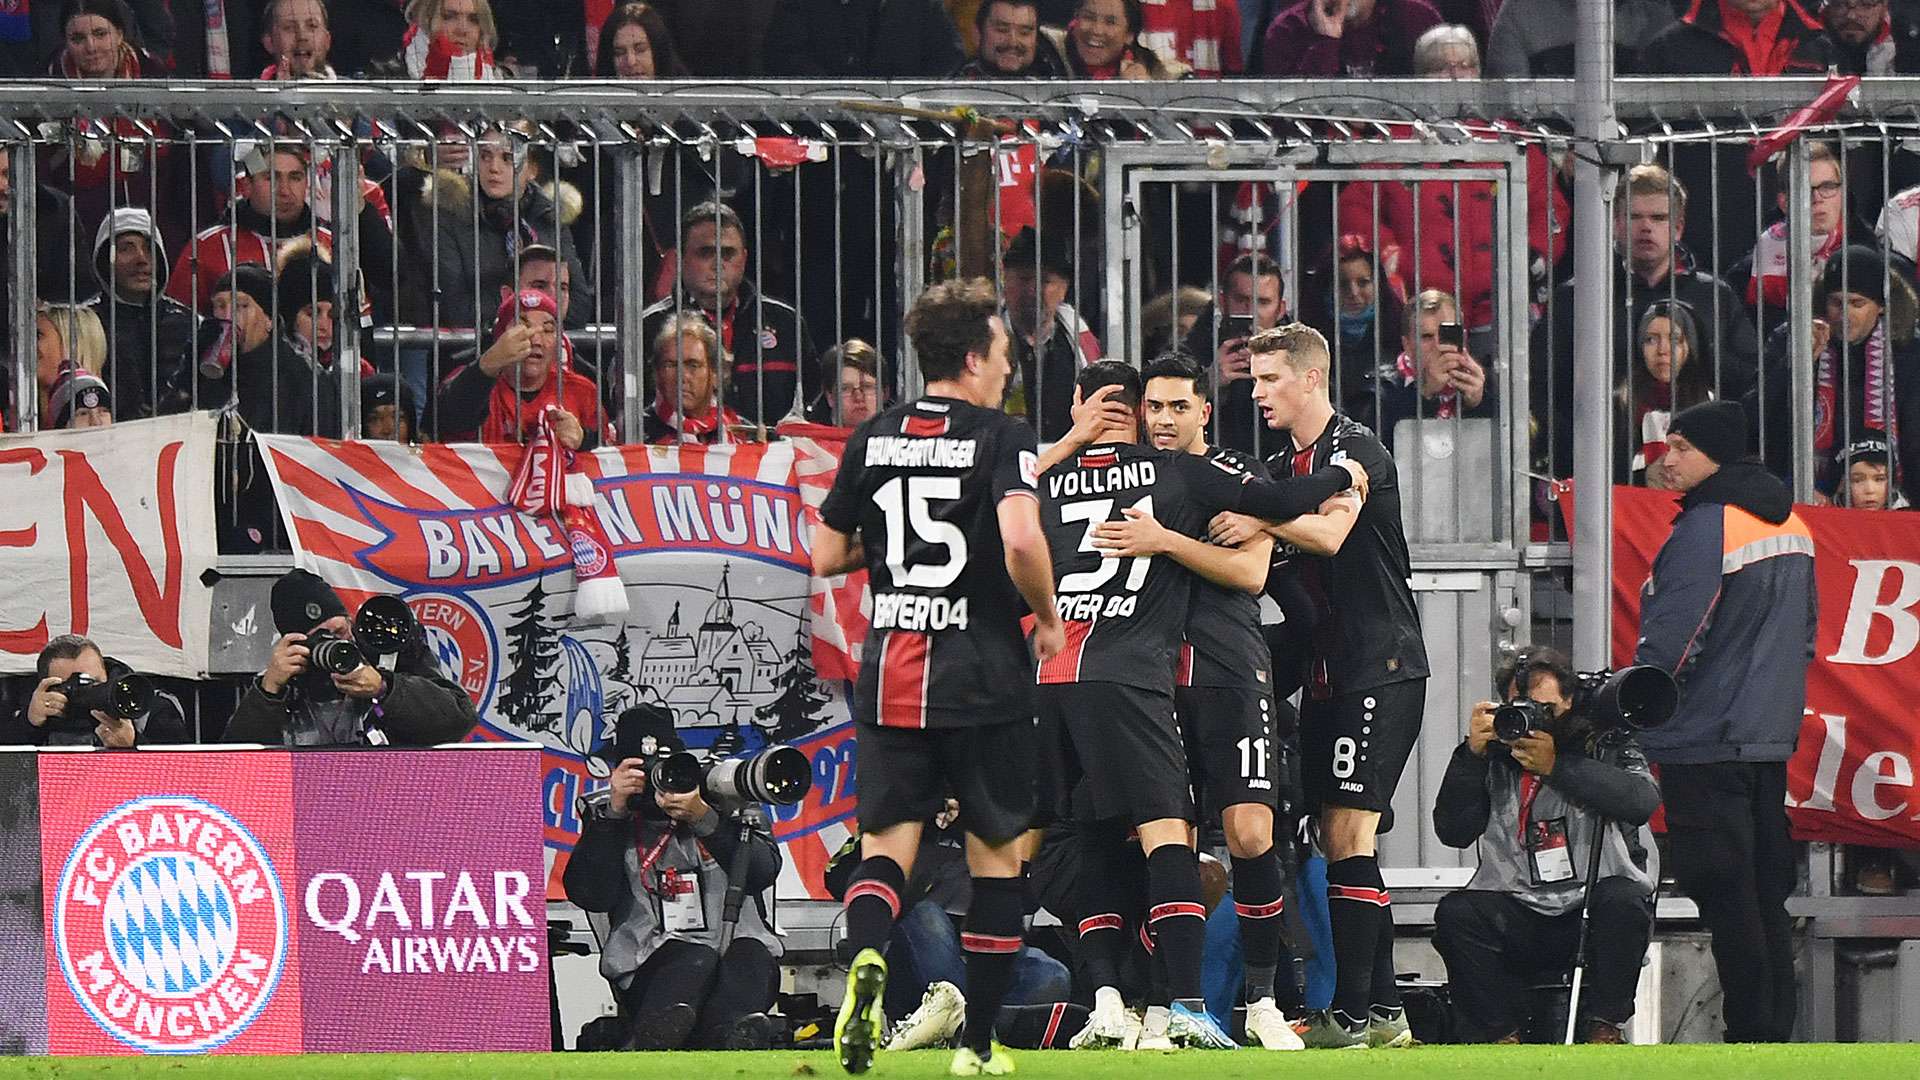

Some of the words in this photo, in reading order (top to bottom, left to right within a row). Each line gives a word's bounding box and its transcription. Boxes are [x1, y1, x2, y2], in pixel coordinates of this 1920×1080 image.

[1050, 461, 1156, 499] VOLLAND
[419, 488, 643, 578] BAYEN
[872, 476, 968, 588] 15
[1058, 494, 1154, 593] 31
[410, 602, 466, 632] YERN
[1236, 737, 1266, 778] 11
[1332, 736, 1357, 779] 8
[1248, 779, 1272, 790] JAKO
[1339, 781, 1364, 793] JAKO
[72, 848, 116, 906] FC
[116, 813, 265, 904] BAYERN
[304, 870, 536, 944] QATAR
[361, 936, 540, 974] AIRWAYS
